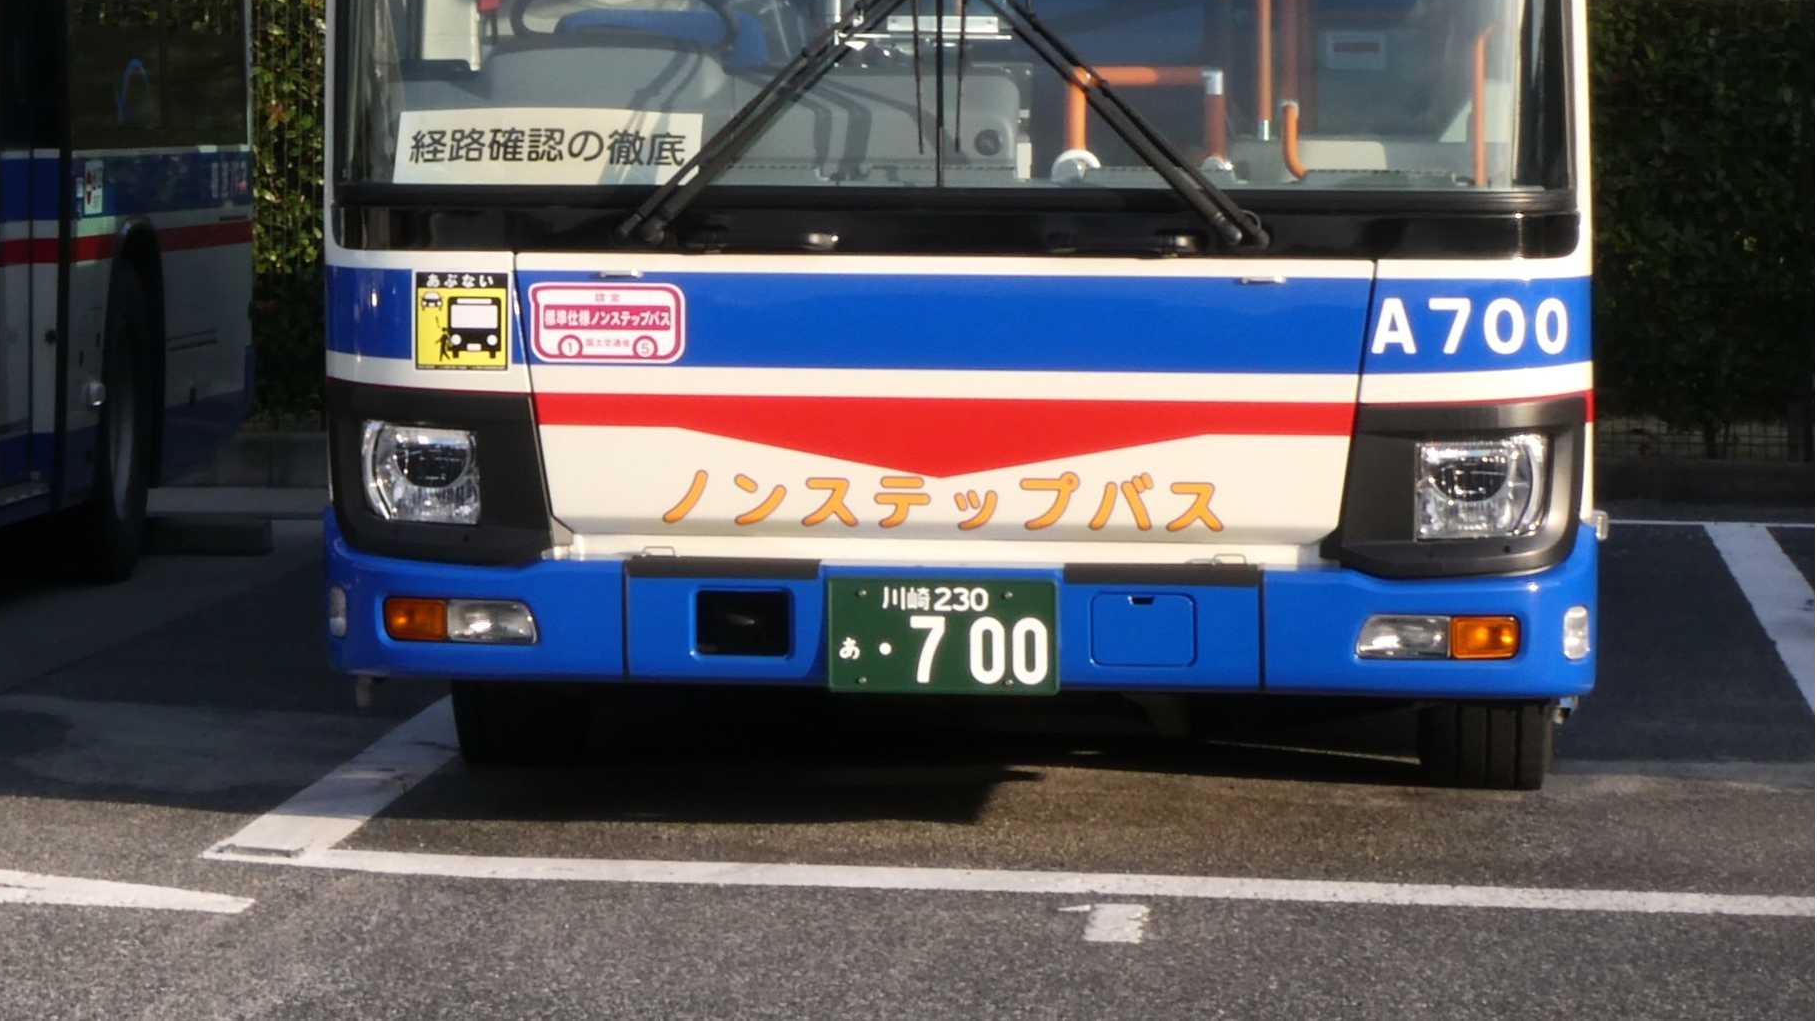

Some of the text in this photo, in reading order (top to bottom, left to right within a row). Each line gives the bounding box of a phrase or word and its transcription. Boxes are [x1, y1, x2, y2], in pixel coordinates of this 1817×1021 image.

[409, 128, 686, 167] 経路確認の徹底
[426, 274, 494, 287] あぶない
[1370, 296, 1569, 356] A700
[662, 468, 1224, 534] ノンステップバス
